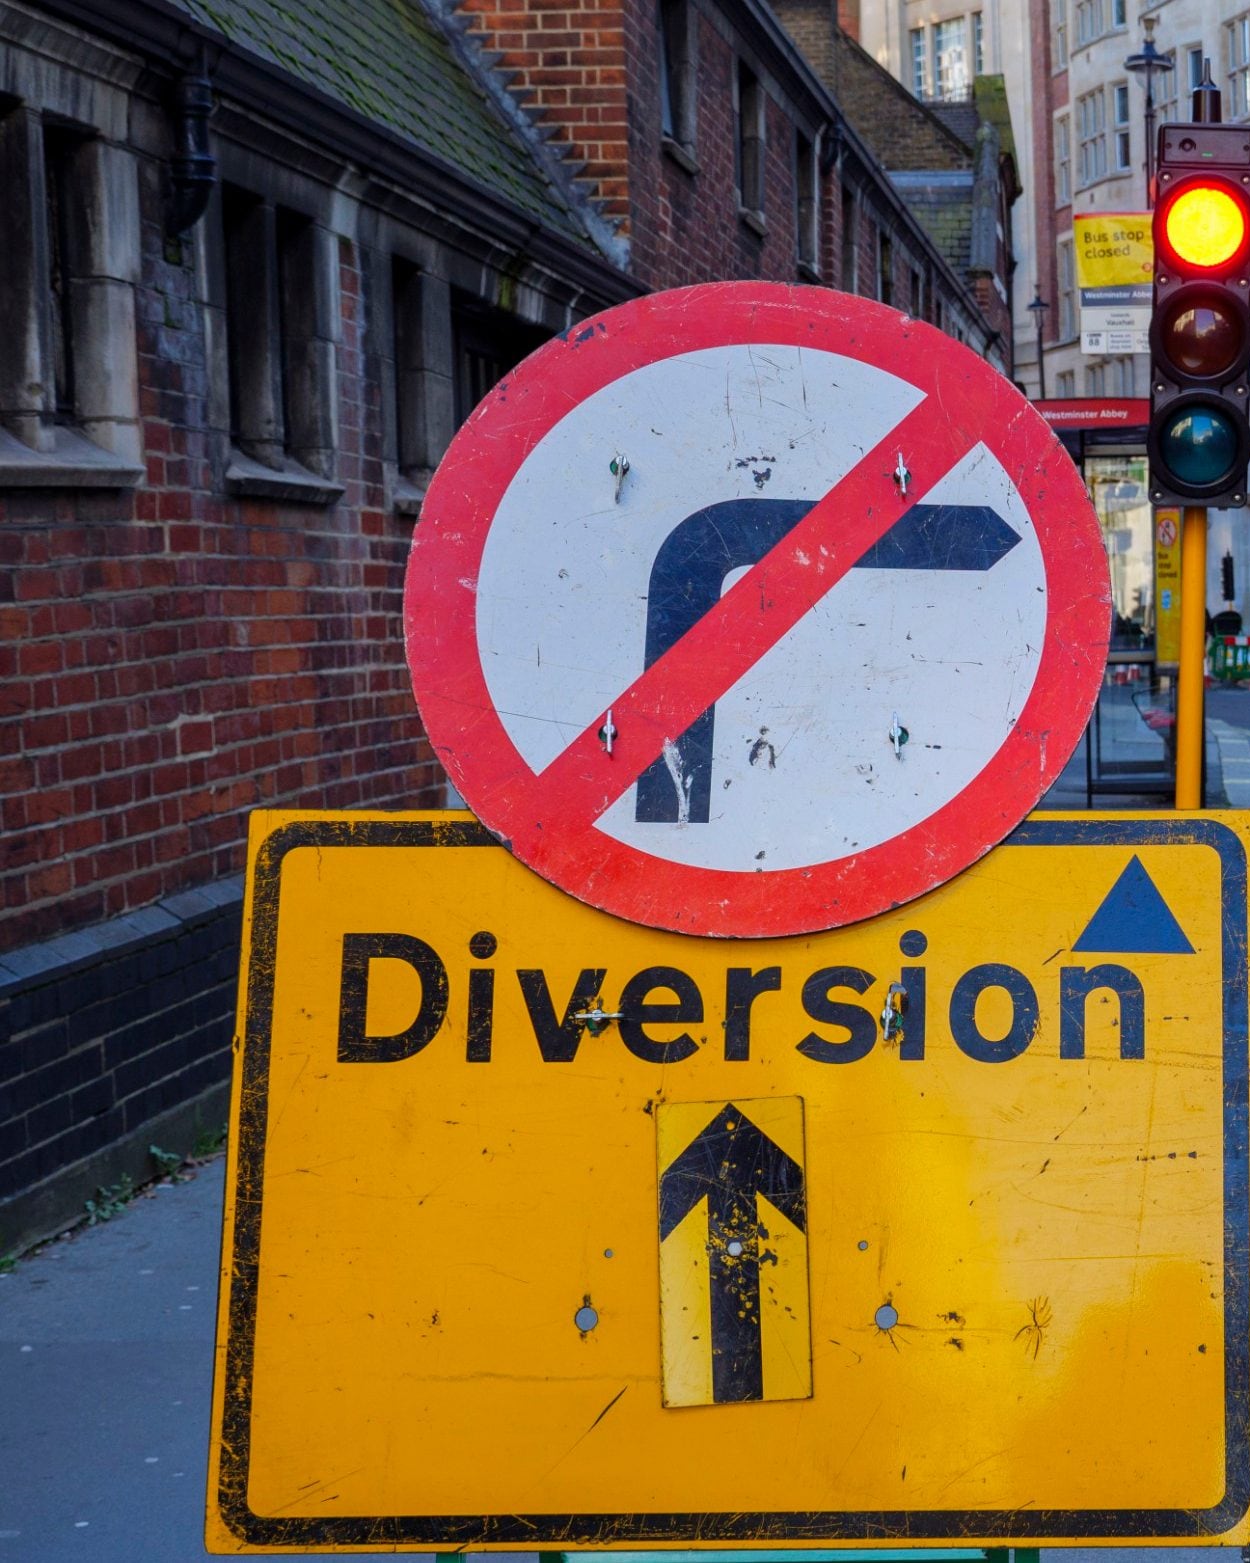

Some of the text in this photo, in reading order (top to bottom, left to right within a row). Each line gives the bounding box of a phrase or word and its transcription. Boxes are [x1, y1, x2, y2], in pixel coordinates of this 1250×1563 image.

[1083, 230, 1145, 243] Bus stop
[1084, 244, 1131, 259] closed
[1085, 289, 1153, 299] Westminster Abbe
[1089, 338, 1100, 346] 88
[1042, 409, 1128, 419] Westminster Abbey
[336, 929, 1147, 1064] Diversion
